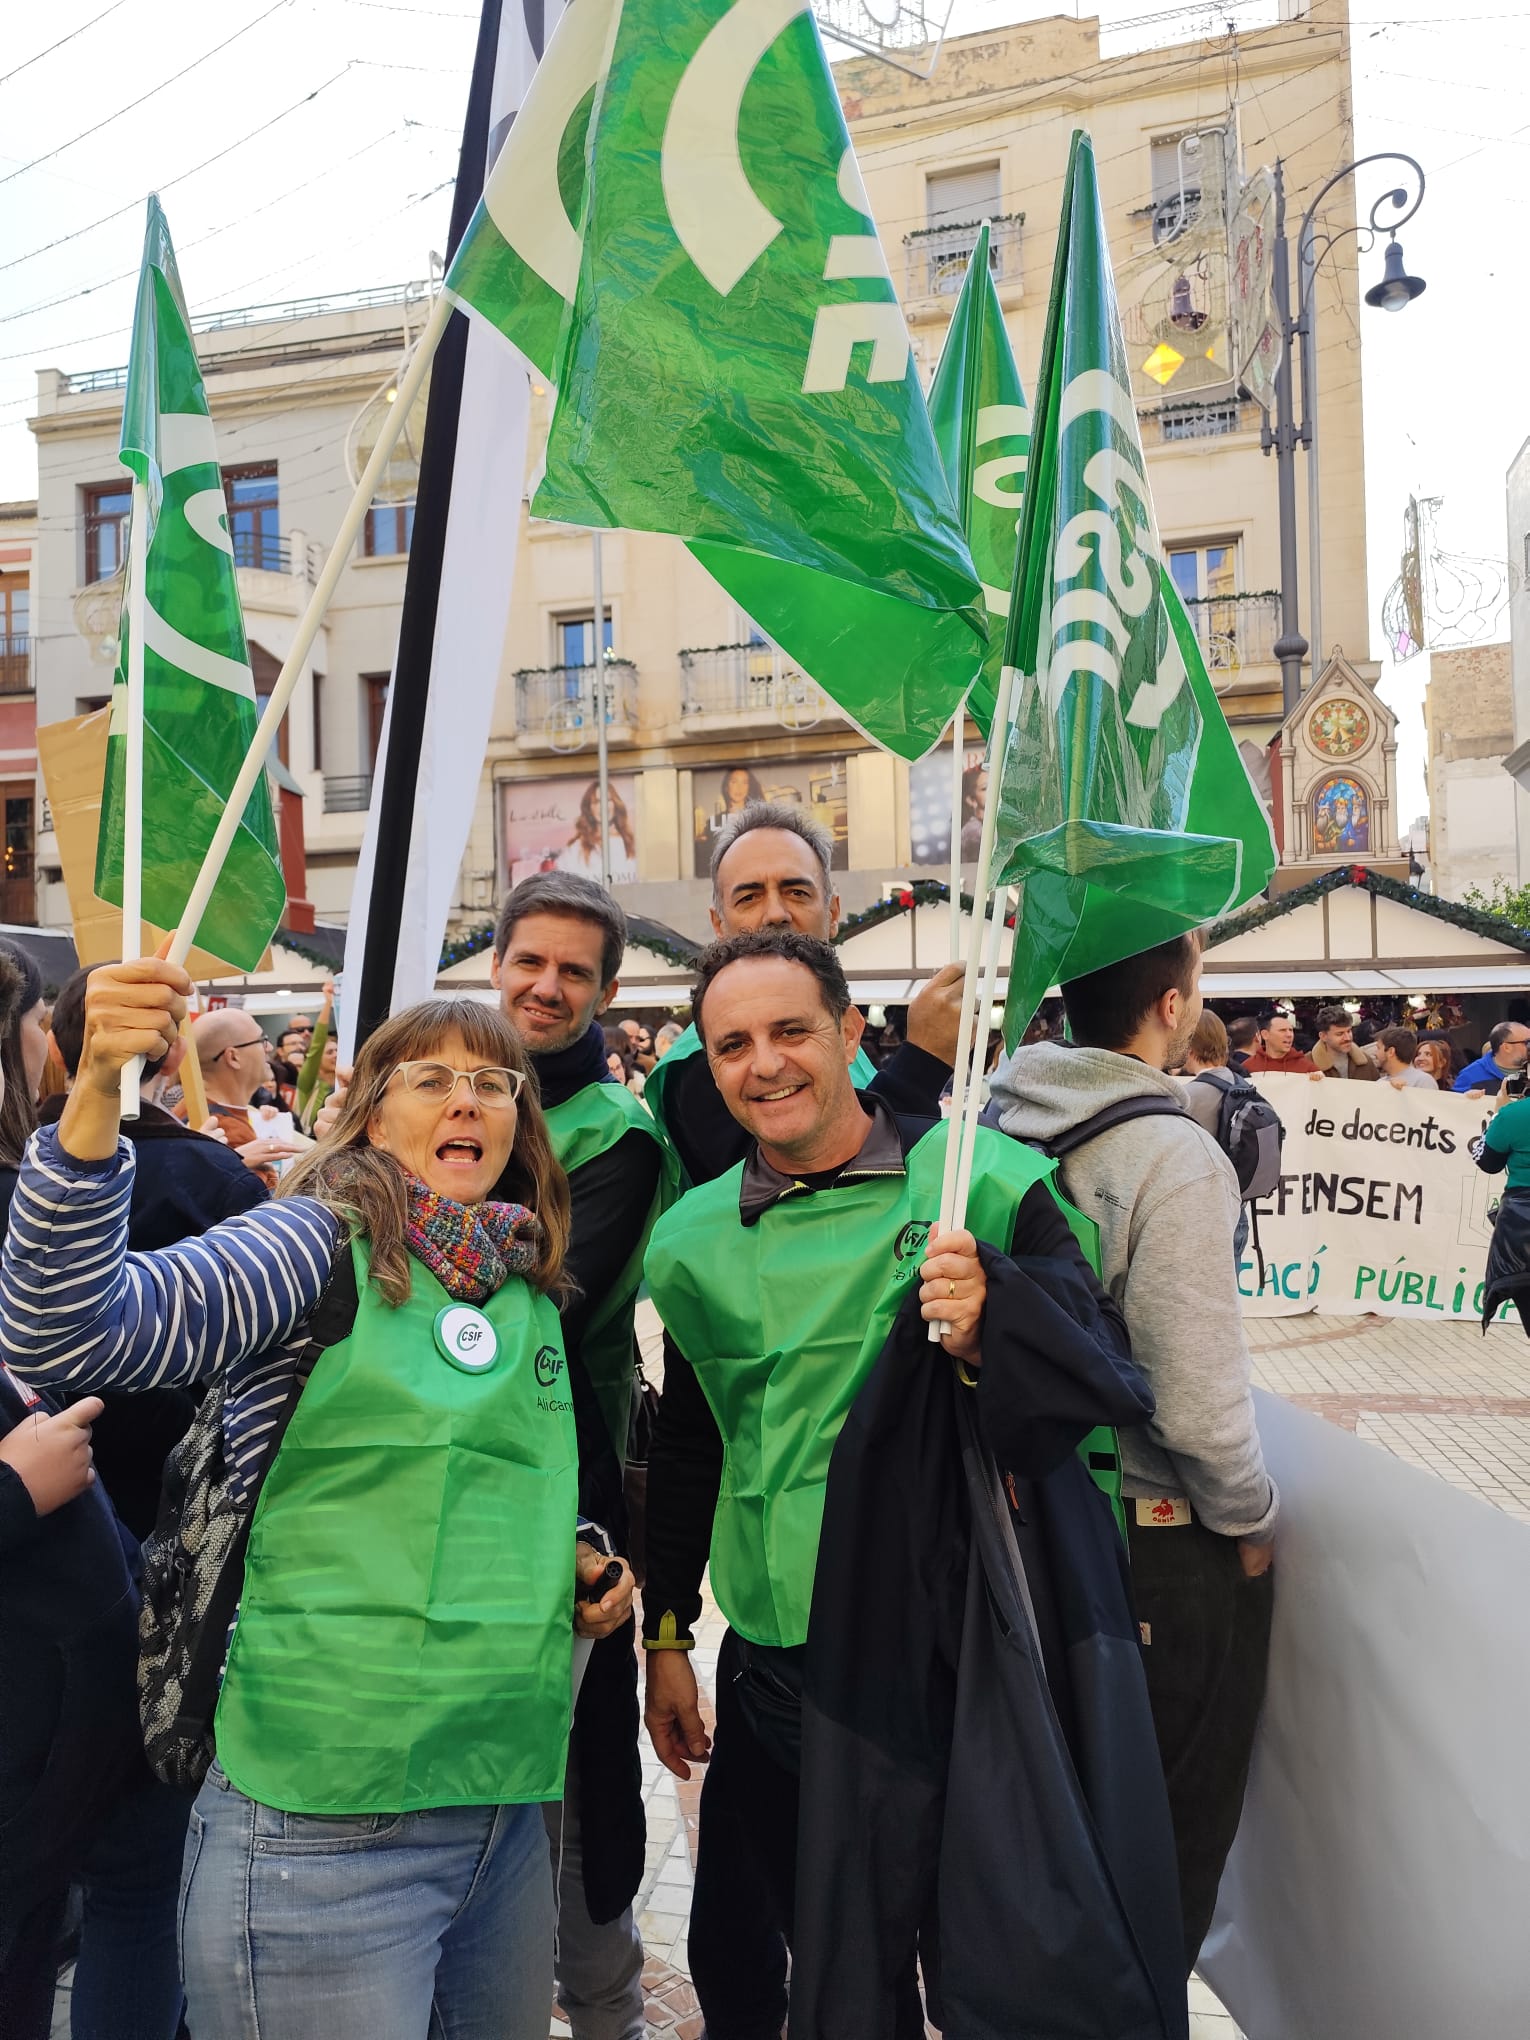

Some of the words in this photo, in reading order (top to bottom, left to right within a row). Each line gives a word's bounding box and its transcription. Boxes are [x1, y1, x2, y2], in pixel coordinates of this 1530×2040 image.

[1304, 1108, 1335, 1137] de
[1341, 1107, 1457, 1154] docents
[462, 1331, 482, 1341] CSIF
[537, 1396, 573, 1411] Alican
